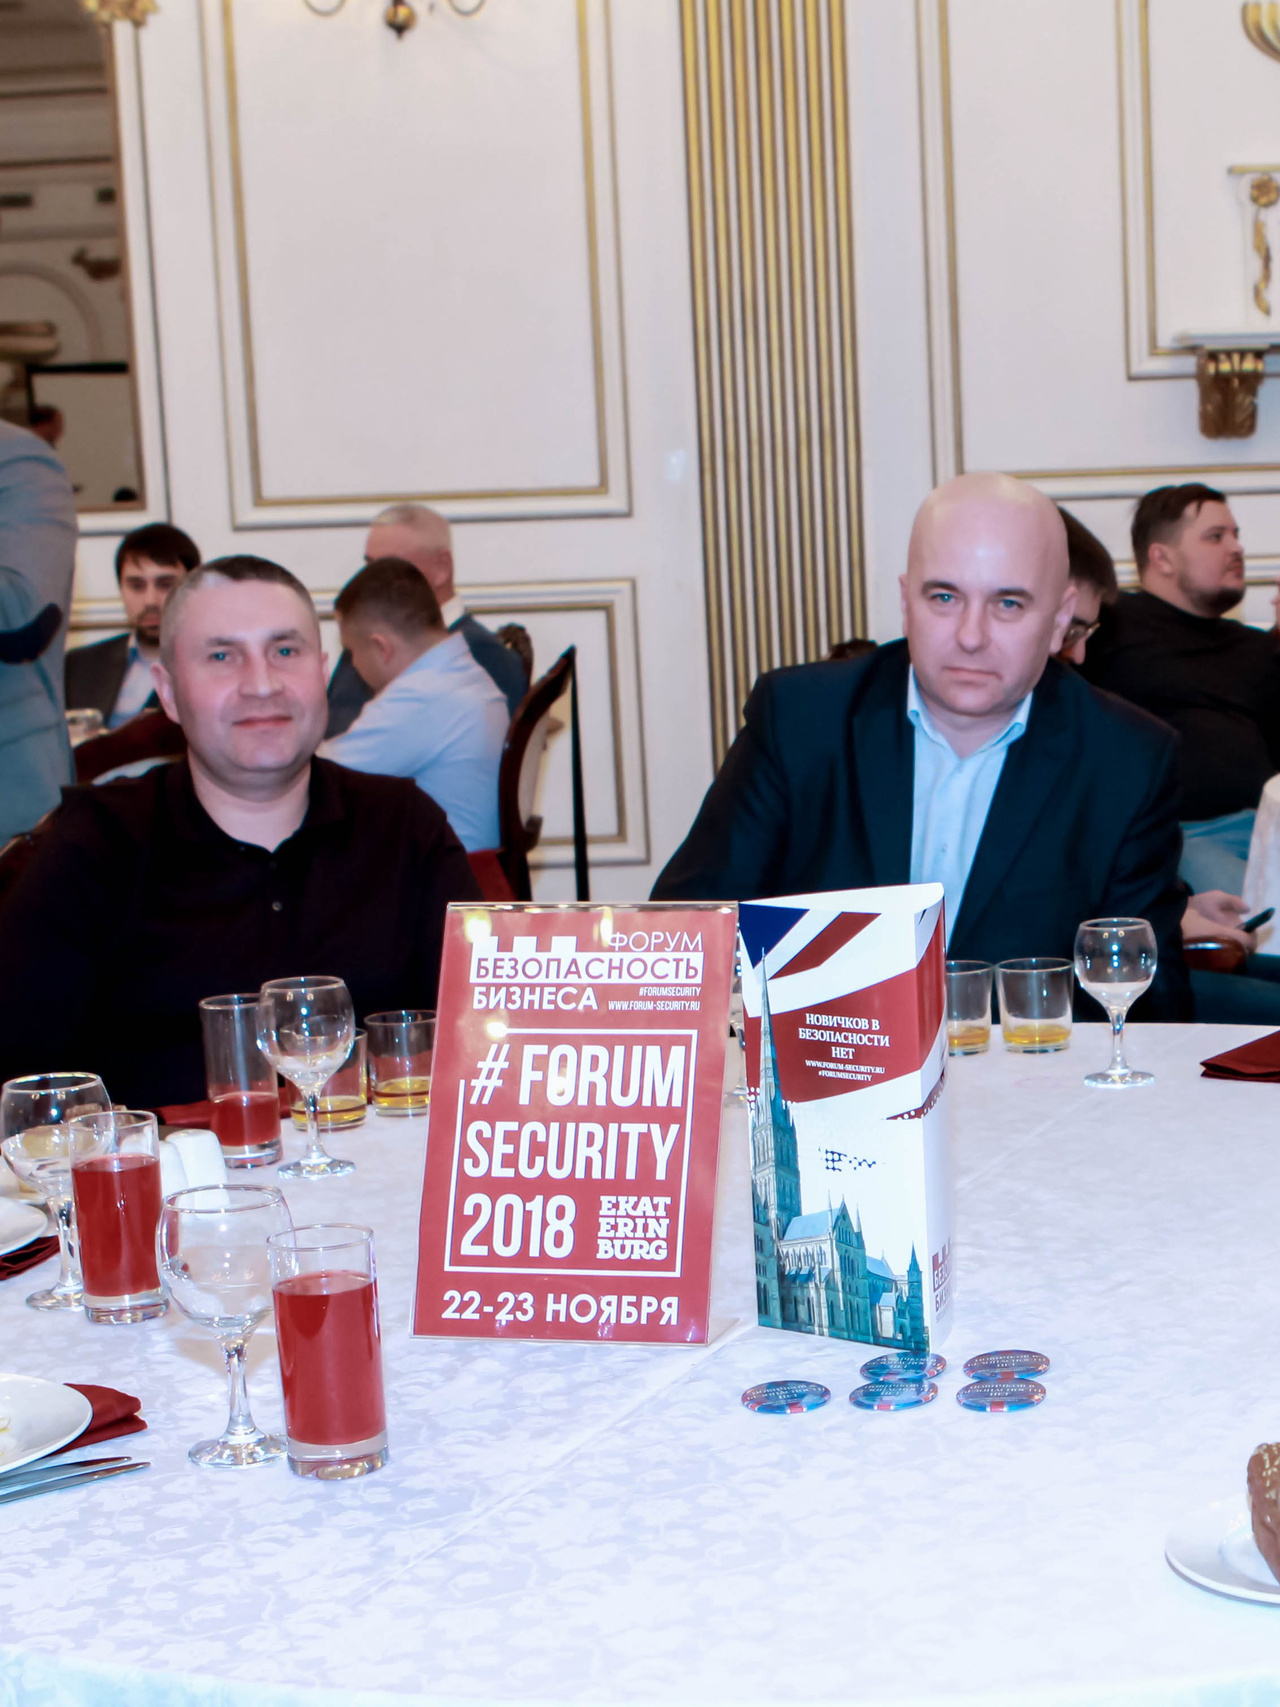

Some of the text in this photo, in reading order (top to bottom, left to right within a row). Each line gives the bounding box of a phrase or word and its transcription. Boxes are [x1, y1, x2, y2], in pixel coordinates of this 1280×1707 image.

[608, 931, 703, 952] ФОРУМ
[475, 957, 700, 980] БЕЗОПАСНОСТЬ
[472, 986, 599, 1011] БИЗНЕСА
[638, 986, 701, 997] #FORUMSECURITY
[608, 1000, 701, 1011] WWW.FORUM-SECURITY.RU
[805, 1012, 880, 1031] НОВИЧКОВ В
[798, 1027, 891, 1047] БЕЗОПАСНОСТИ
[831, 1046, 856, 1060] НЕТ
[519, 1043, 687, 1109] FORUM
[462, 1120, 681, 1182] SECURITY
[598, 1195, 672, 1218] EKAT
[459, 1193, 578, 1260] 2018
[597, 1217, 670, 1239] ERIN
[595, 1239, 669, 1261] BURG
[440, 1289, 680, 1327] 22-23 НОЯБРЯ
